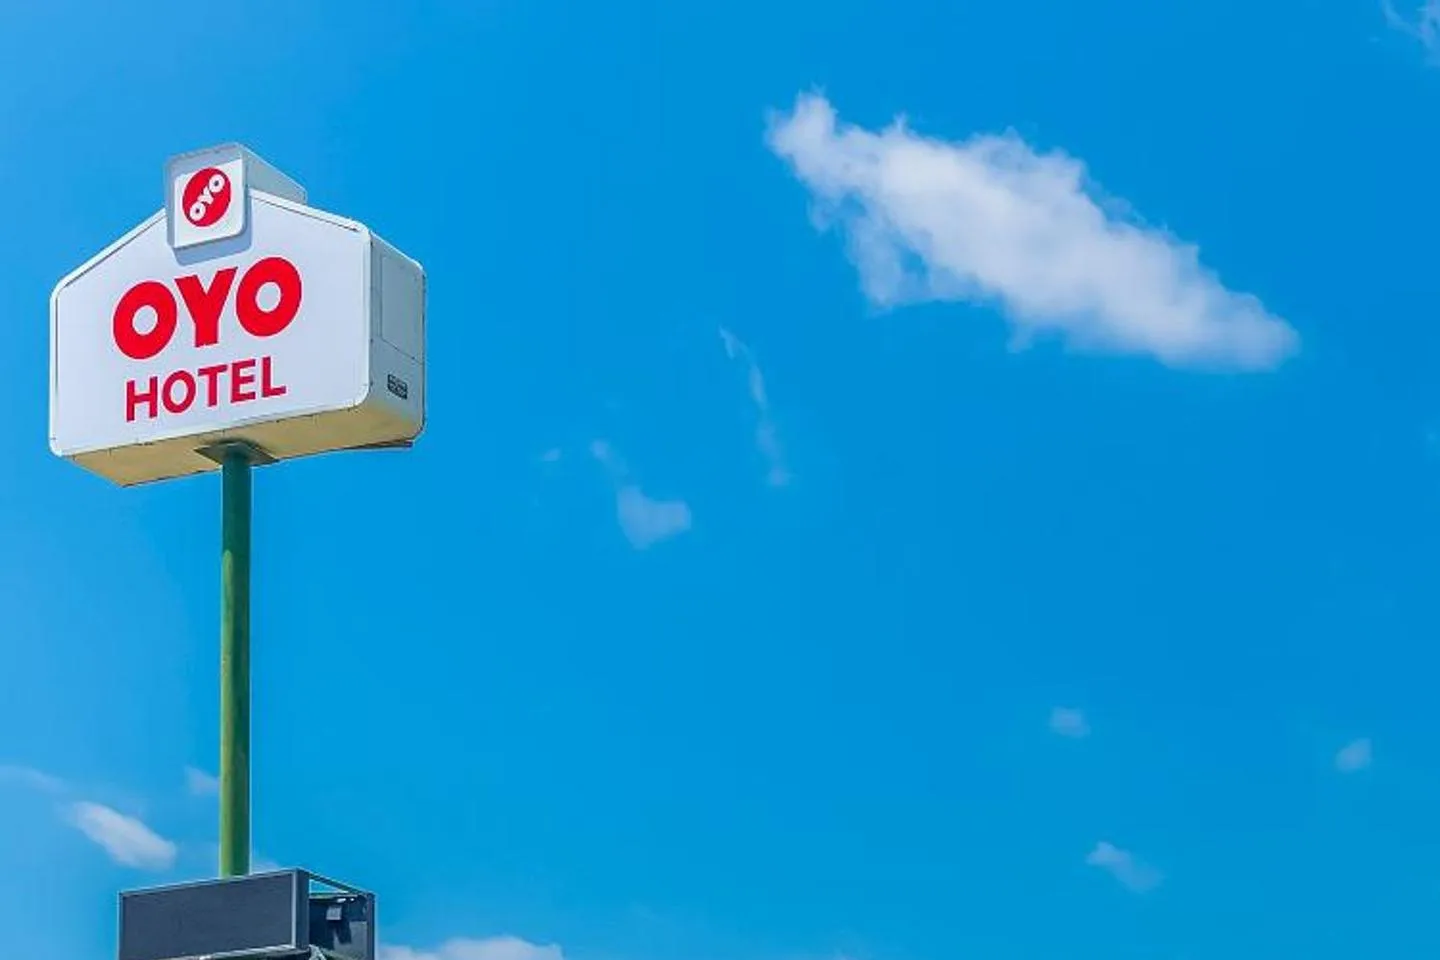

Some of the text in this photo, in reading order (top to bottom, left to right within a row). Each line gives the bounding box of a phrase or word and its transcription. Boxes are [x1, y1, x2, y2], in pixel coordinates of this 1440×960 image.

[190, 174, 226, 221] OYO
[112, 256, 303, 360] OYO
[125, 356, 286, 421] HOTEL
